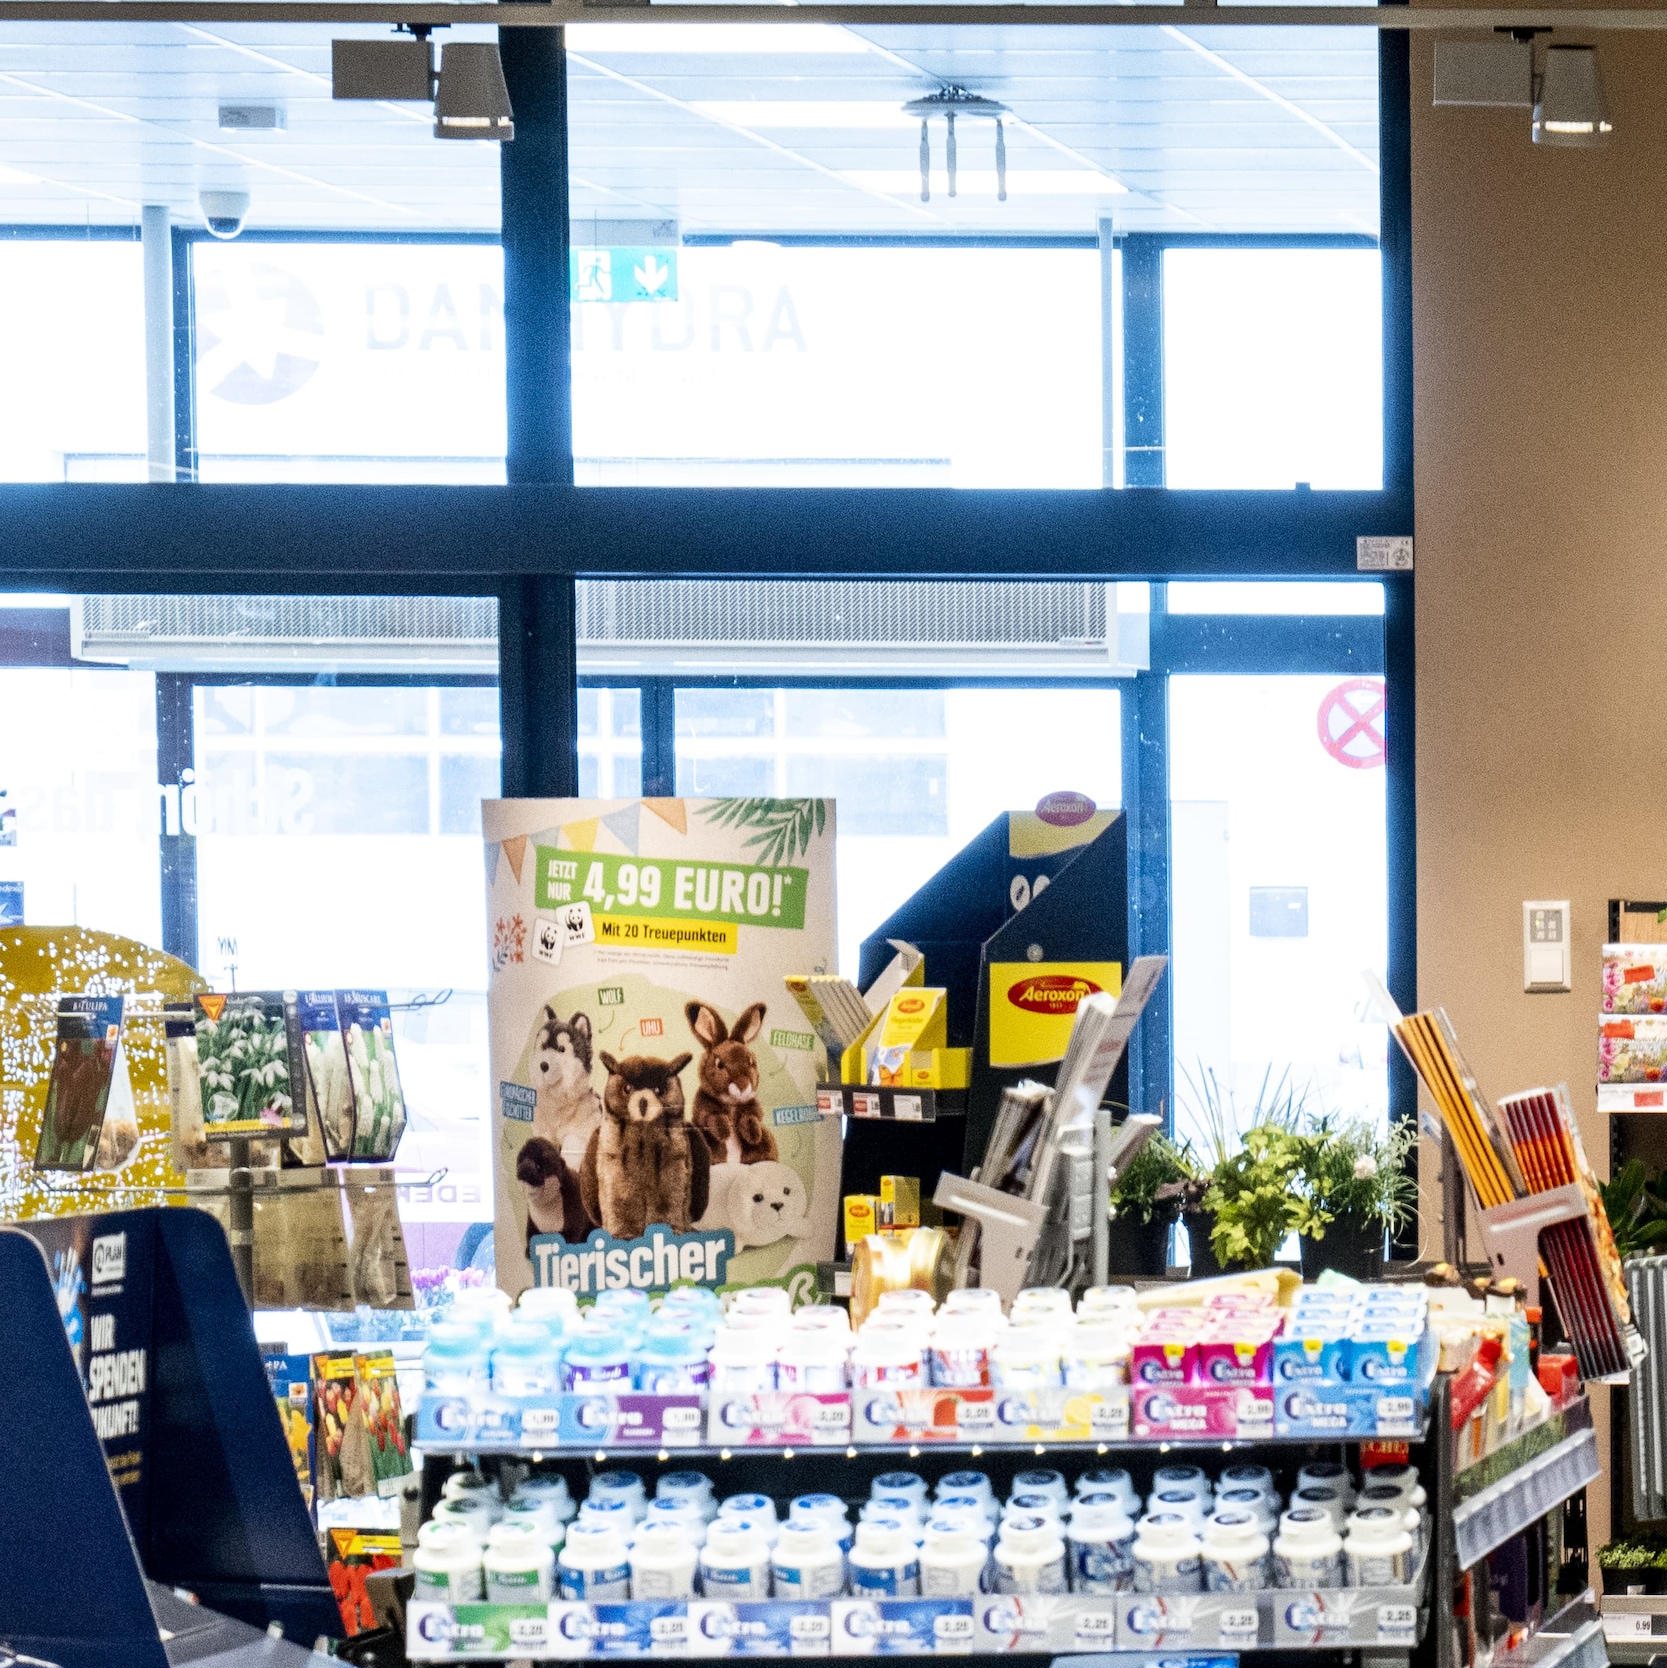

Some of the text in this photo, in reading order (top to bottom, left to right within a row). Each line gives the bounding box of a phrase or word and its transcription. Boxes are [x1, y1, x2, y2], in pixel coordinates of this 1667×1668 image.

[1039, 799, 1085, 815] Aeroxon
[548, 860, 577, 880] JETZT
[547, 883, 571, 900] NUR
[583, 861, 662, 912] 4,99
[602, 923, 727, 944] Mit 20 Treuepunkten
[601, 989, 622, 1003] WOLF
[1019, 985, 1085, 1003] Aeroxon
[641, 1019, 662, 1034] UHU
[534, 1233, 726, 1294] Tierischer
[91, 1313, 116, 1351] WIR
[89, 1347, 147, 1402] SPENDEN
[1635, 1620, 1651, 1632] 0.99
